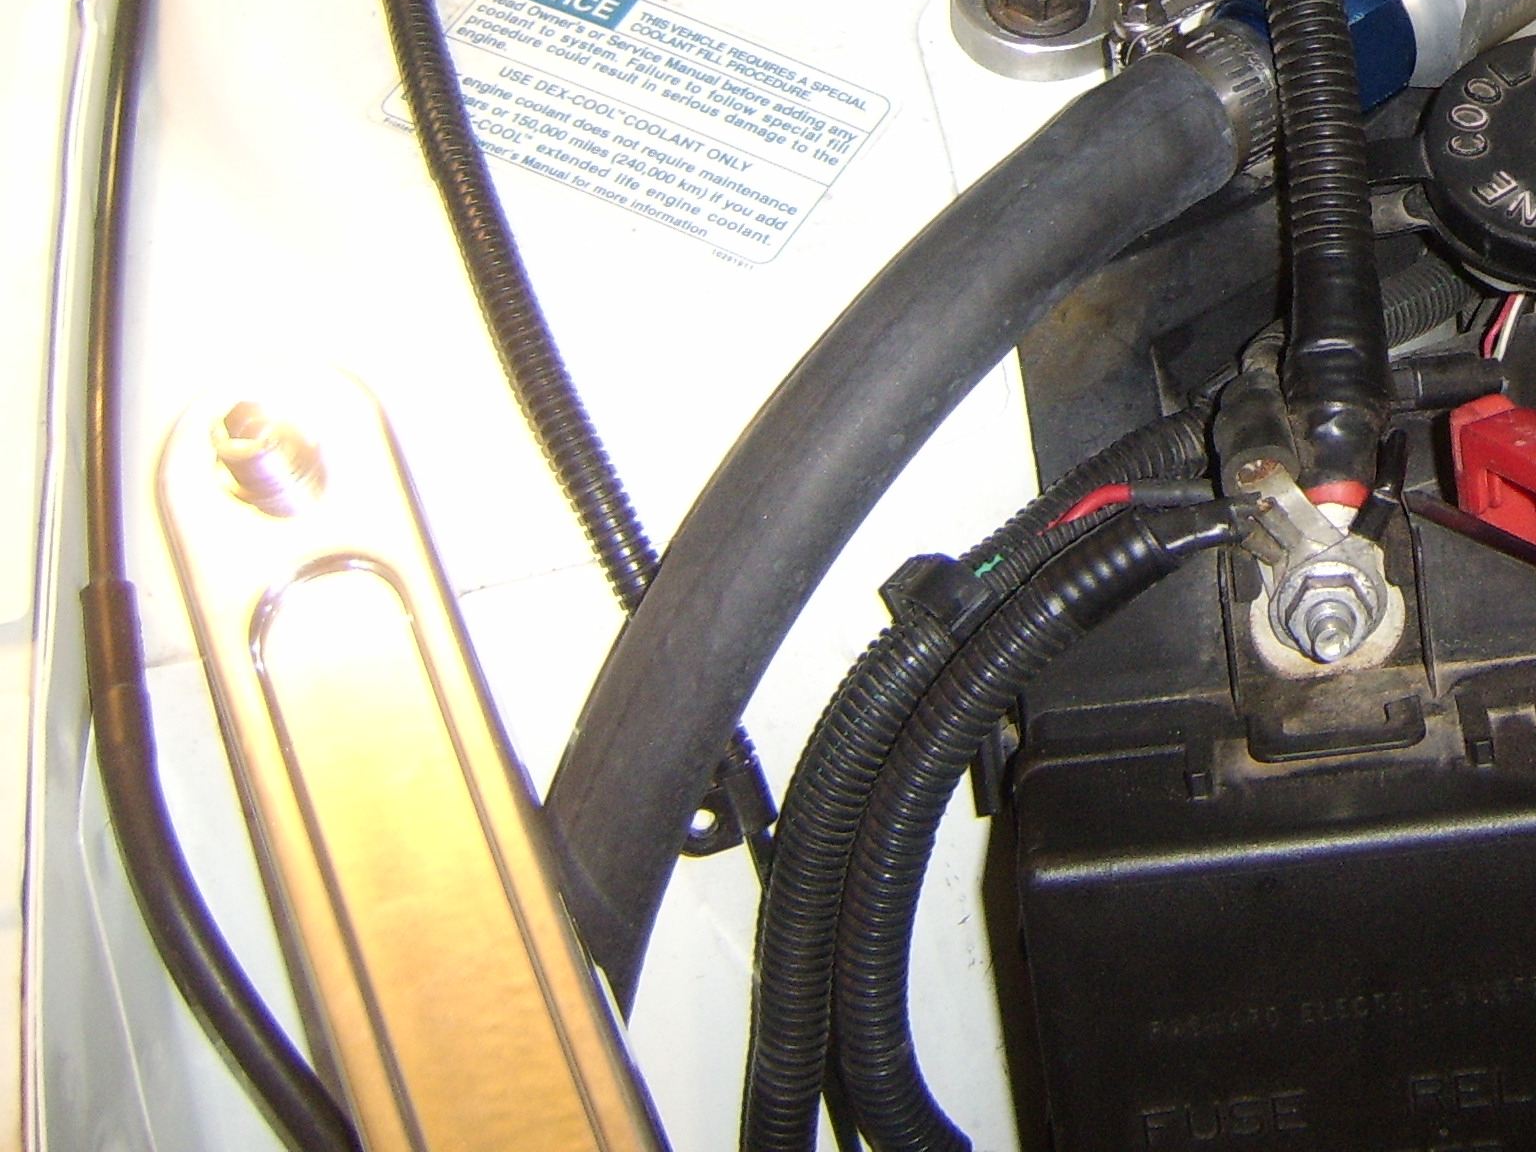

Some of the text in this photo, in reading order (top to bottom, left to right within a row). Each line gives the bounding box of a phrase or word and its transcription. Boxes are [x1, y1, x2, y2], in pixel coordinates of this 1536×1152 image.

[465, 15, 839, 165] procedure could result in serious damage to the
[476, 5, 535, 29] coolant
[539, 25, 555, 37] to
[626, 57, 681, 85] Failure
[685, 81, 701, 94] to
[707, 90, 757, 115] follow
[762, 114, 822, 142] special
[827, 139, 850, 154] fill
[527, 6, 585, 33] Owner's
[588, 30, 605, 40] or
[607, 35, 662, 63] Service
[664, 57, 721, 85] Manual
[721, 80, 770, 106] before
[772, 104, 826, 131] adding
[828, 126, 858, 143] any
[631, 23, 696, 52] COOLANT
[696, 48, 722, 65] FILL
[640, 12, 865, 111] THIS VEHICLE REQUIRES A SPECIAL
[462, 77, 797, 215] engine coolant does not require maintenance
[492, 107, 509, 117] or
[512, 113, 568, 140] 150,000
[569, 137, 609, 157] miles
[709, 192, 723, 203] if
[721, 200, 753, 216] you
[755, 214, 788, 230] add
[499, 67, 533, 85] USE
[624, 115, 705, 152] COOLANT
[707, 149, 752, 171] ONLY
[521, 155, 570, 179] Manual
[571, 176, 590, 188] for
[593, 186, 627, 204] more
[630, 200, 707, 237] information
[536, 144, 611, 177] extended
[615, 173, 640, 190] life
[646, 188, 701, 215] engine
[707, 214, 771, 245] coolant.
[1137, 1089, 1307, 1150] FUSE
